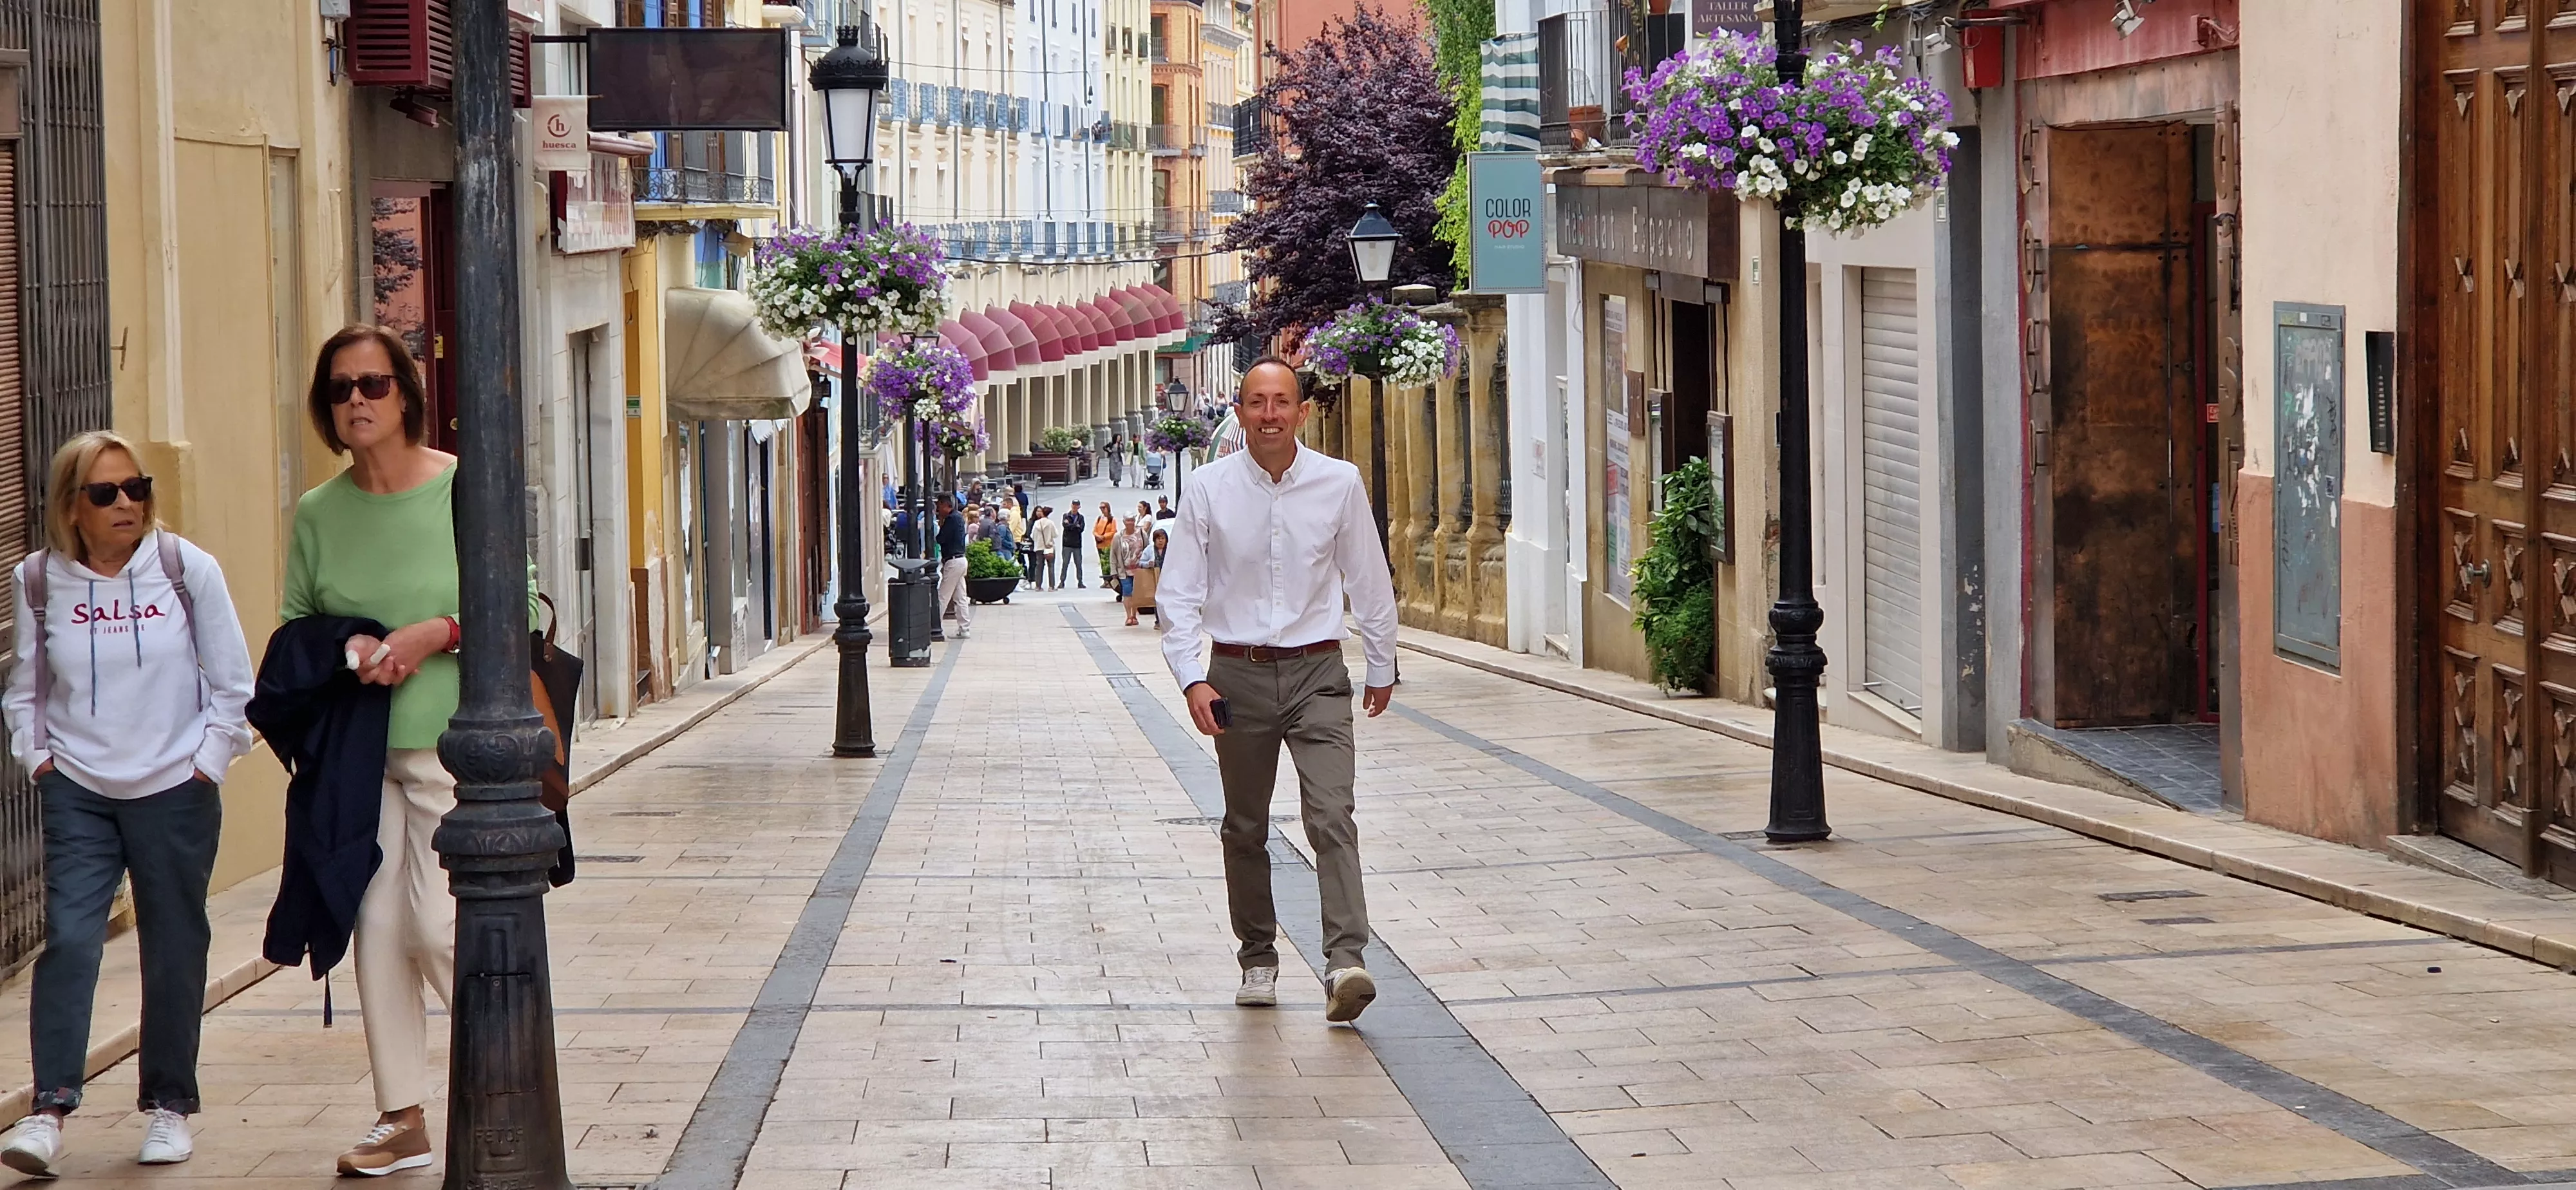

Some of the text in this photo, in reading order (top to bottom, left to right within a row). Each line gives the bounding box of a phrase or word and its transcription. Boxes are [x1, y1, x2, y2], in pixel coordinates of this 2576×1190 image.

[1707, 1, 1748, 11] TALLER
[1698, 14, 1759, 23] ARTESANO
[542, 140, 576, 149] huesca
[1486, 198, 1531, 218] COLOR
[1488, 219, 1530, 239] POP
[1633, 205, 1693, 265] Espacio
[71, 599, 166, 624] Salsa
[103, 625, 129, 634] JEANS
